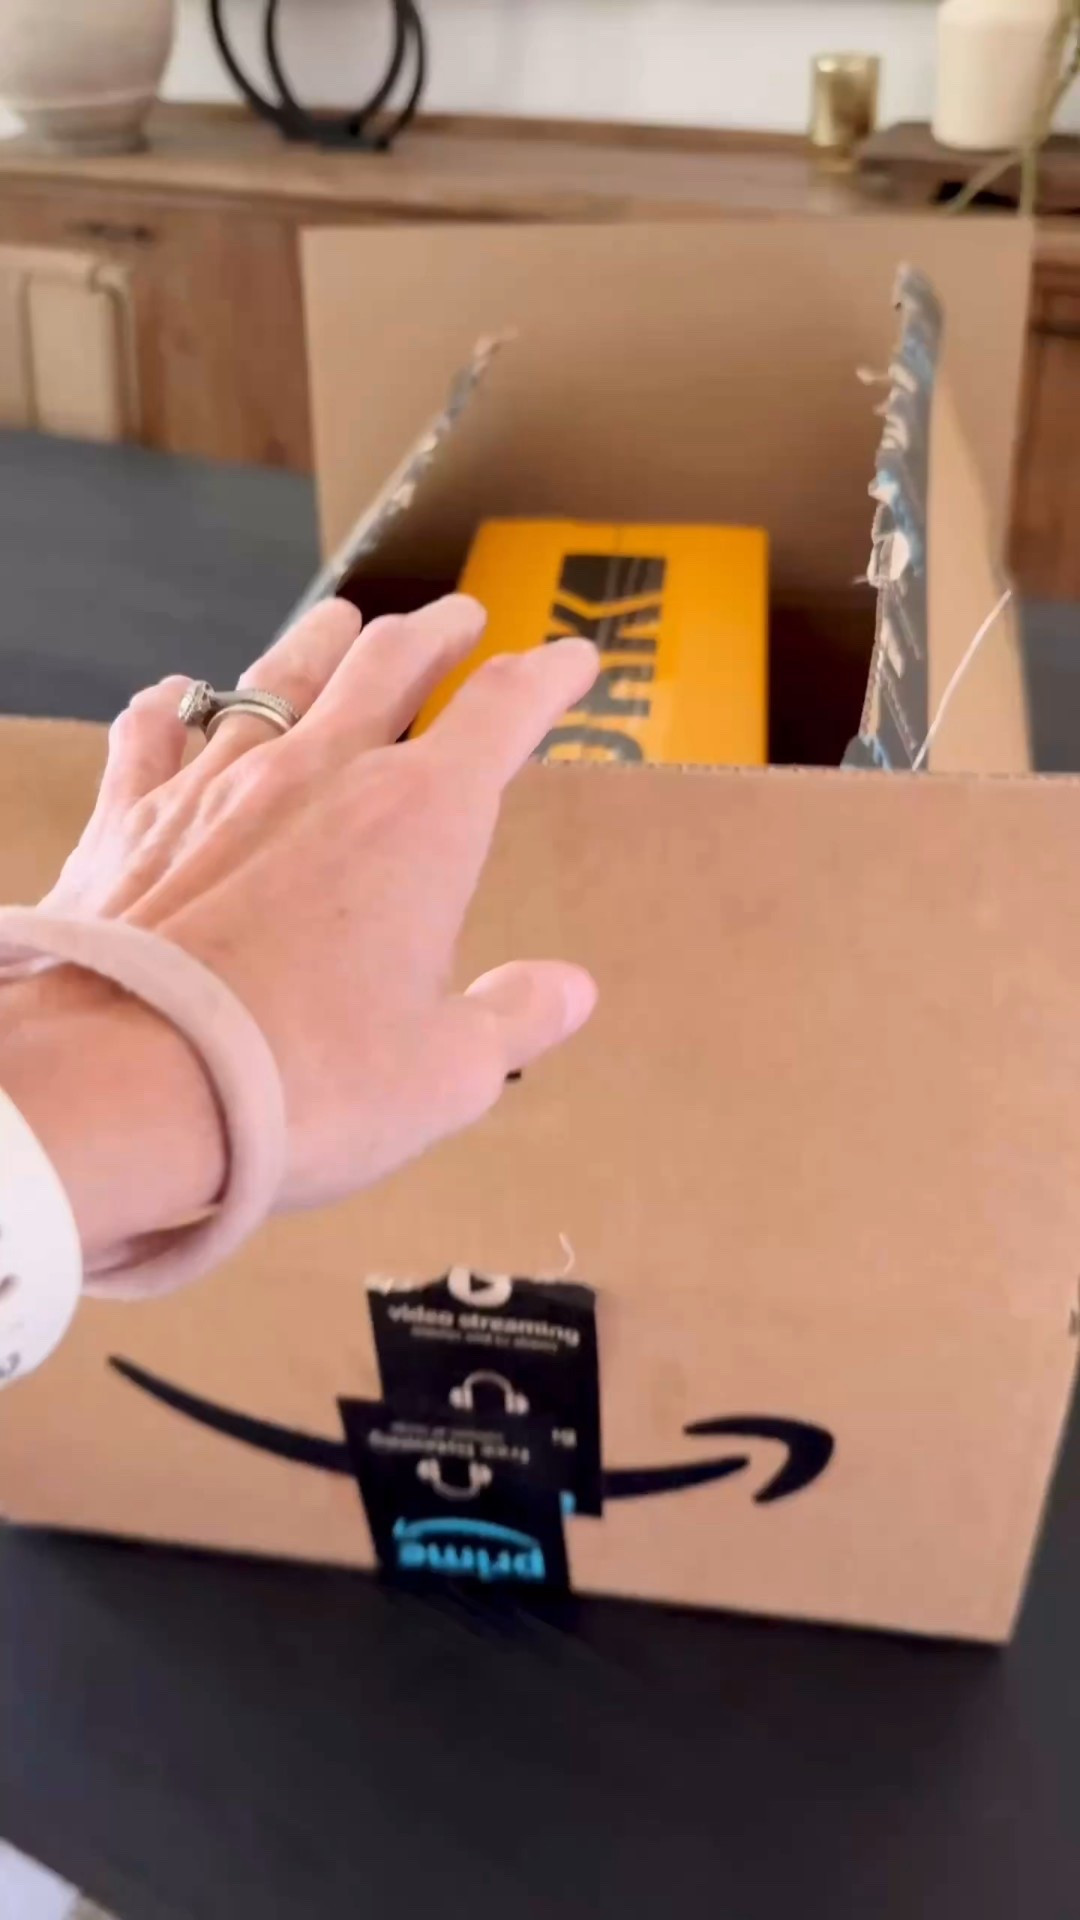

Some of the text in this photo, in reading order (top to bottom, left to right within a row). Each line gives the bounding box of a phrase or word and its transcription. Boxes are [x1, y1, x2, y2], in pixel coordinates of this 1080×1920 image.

[387, 1304, 455, 1327] video
[458, 1312, 580, 1348] streaming
[398, 1541, 545, 1581] prime
